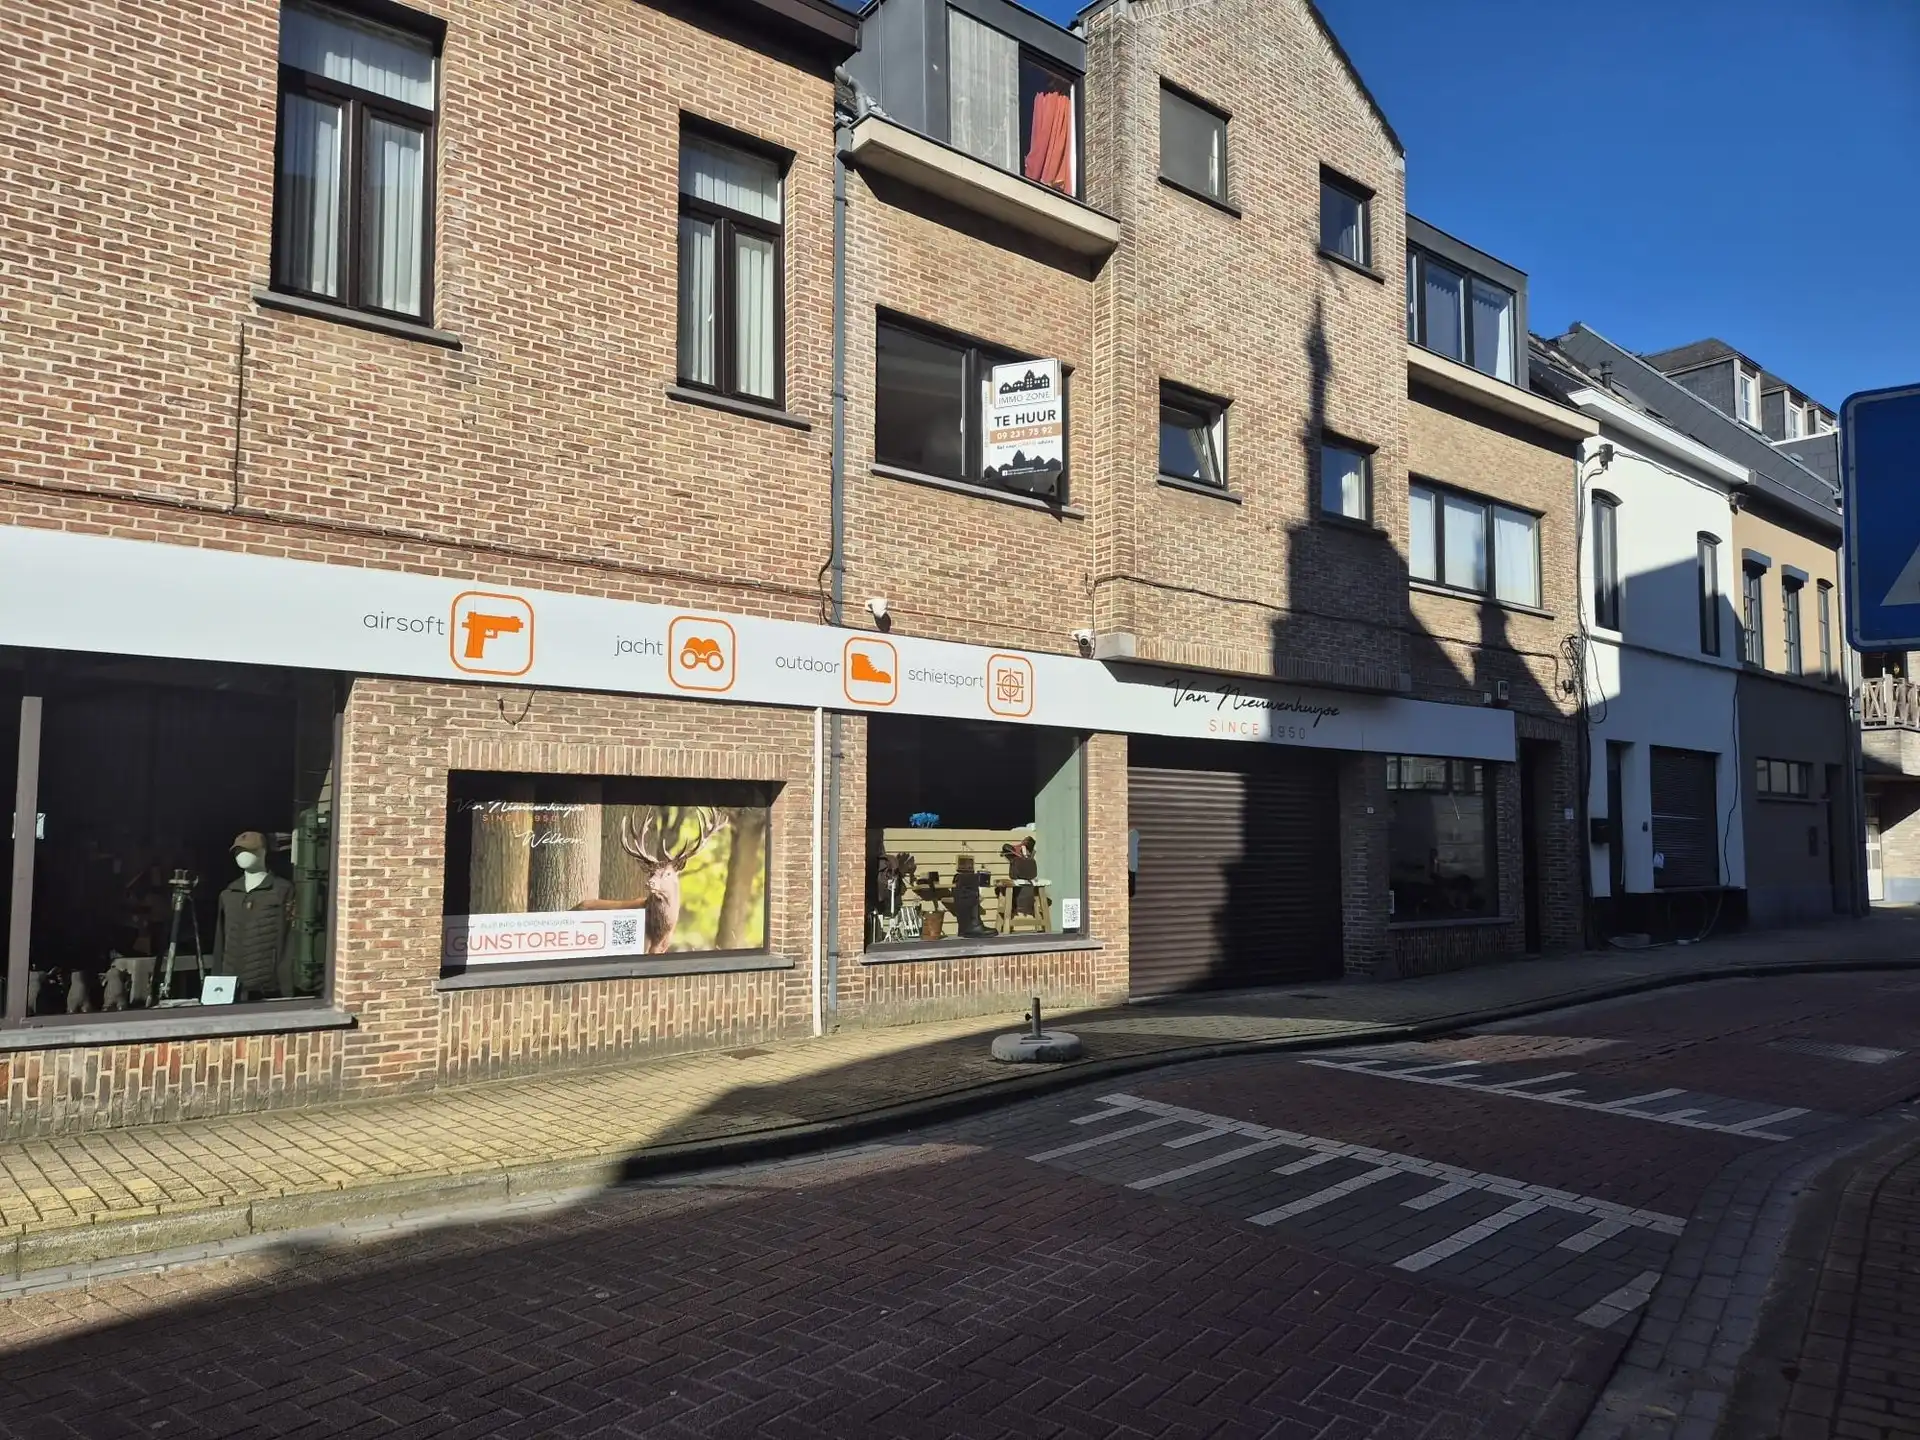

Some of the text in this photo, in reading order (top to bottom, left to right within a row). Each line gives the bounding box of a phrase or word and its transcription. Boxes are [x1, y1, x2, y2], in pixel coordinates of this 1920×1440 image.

[998, 391, 1050, 405] IMMO ZONE
[994, 410, 1056, 427] TE HUUR
[997, 431, 1008, 440] 09
[1010, 429, 1025, 438] 231
[1041, 426, 1053, 435] 92
[363, 610, 445, 636] airsoft
[614, 635, 663, 657] jacht
[775, 655, 840, 674] outdoor
[908, 667, 984, 688] schietsport
[1165, 678, 1340, 728] Van Nieuwenhuyse
[1208, 719, 1306, 740] SINCE 1950
[482, 814, 519, 823] SINC
[452, 930, 598, 952] GUNSTORE.be
